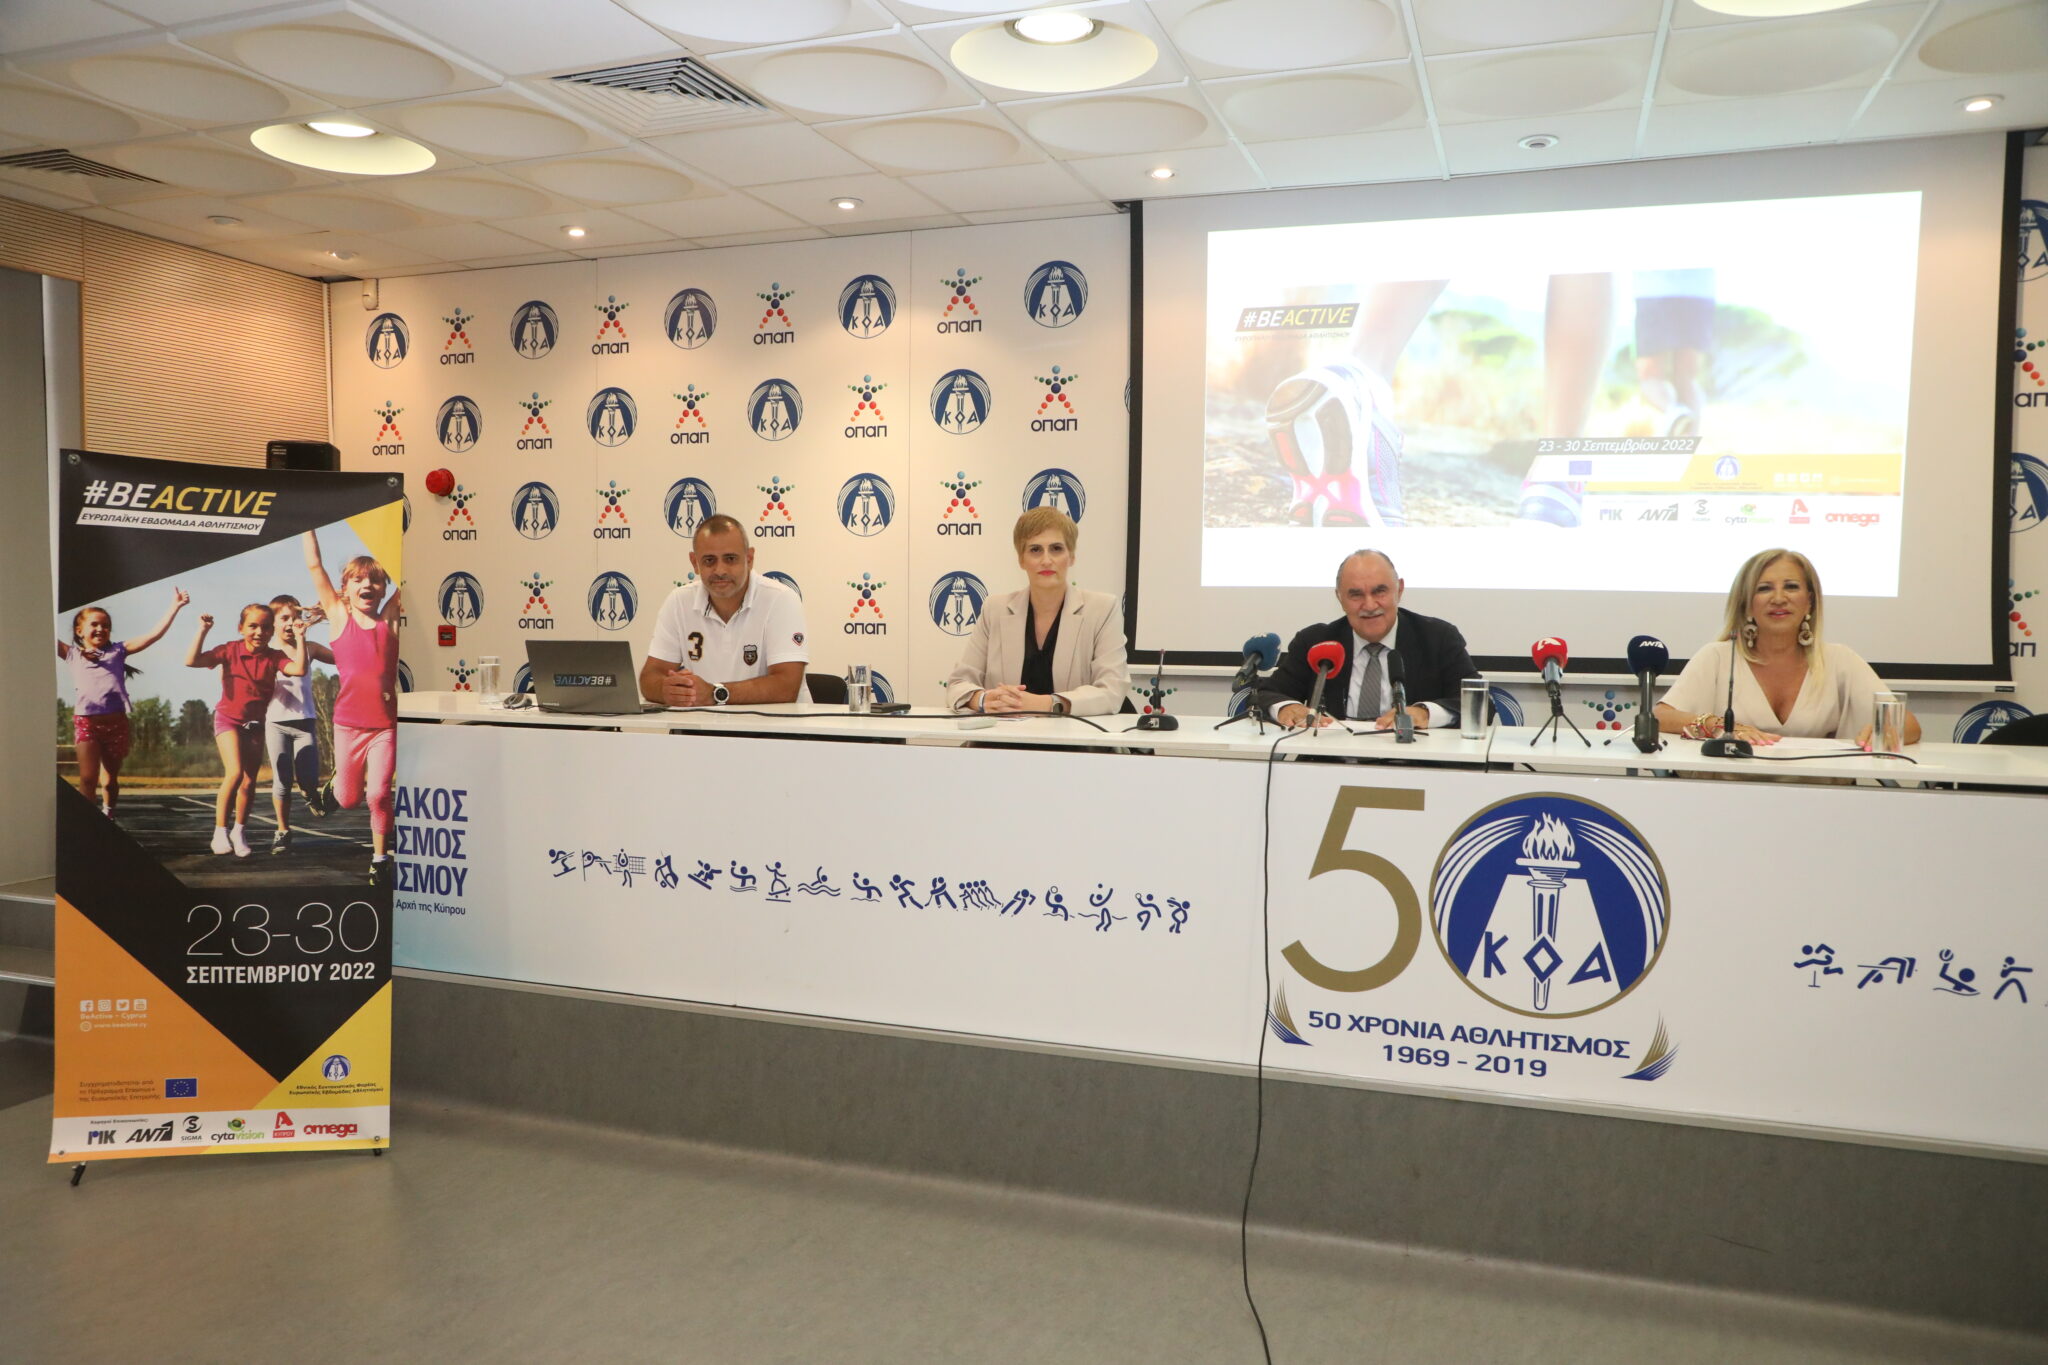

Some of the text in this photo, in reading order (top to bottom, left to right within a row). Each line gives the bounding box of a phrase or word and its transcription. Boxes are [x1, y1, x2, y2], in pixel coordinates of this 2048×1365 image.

[1244, 307, 1354, 328] #BEACTIVE
[1539, 441, 1554, 451] 23
[1565, 440, 1580, 451] 30
[1582, 439, 1659, 453] Σεπτεμβρίου
[1661, 440, 1694, 451] 2022
[83, 479, 277, 516] #BEACTIVE
[81, 512, 261, 531] ΕΥΡΩΠΑΪΚΗ ΕΒΔΟΜΑΔΑ ΑΘΛΗΤΙΣΜΟΥ
[1825, 513, 1880, 527] omega
[688, 632, 704, 661] 3
[556, 675, 612, 686] #BEACTIVE
[396, 899, 466, 916] Αρχή της Κύπρου
[186, 901, 380, 957] 23-30
[186, 962, 376, 984] ΣΕΠΤΕΜΒΡΙΟΥ 2022
[1308, 1010, 1631, 1059] 50 ΧΡΟΝΙΑ ΑΘΛΗΤΙΣΜΟΣ
[1382, 1044, 1450, 1067] 1969
[1474, 1053, 1548, 1077] 2019
[211, 1130, 265, 1143] cytavision
[303, 1123, 358, 1138] omega
